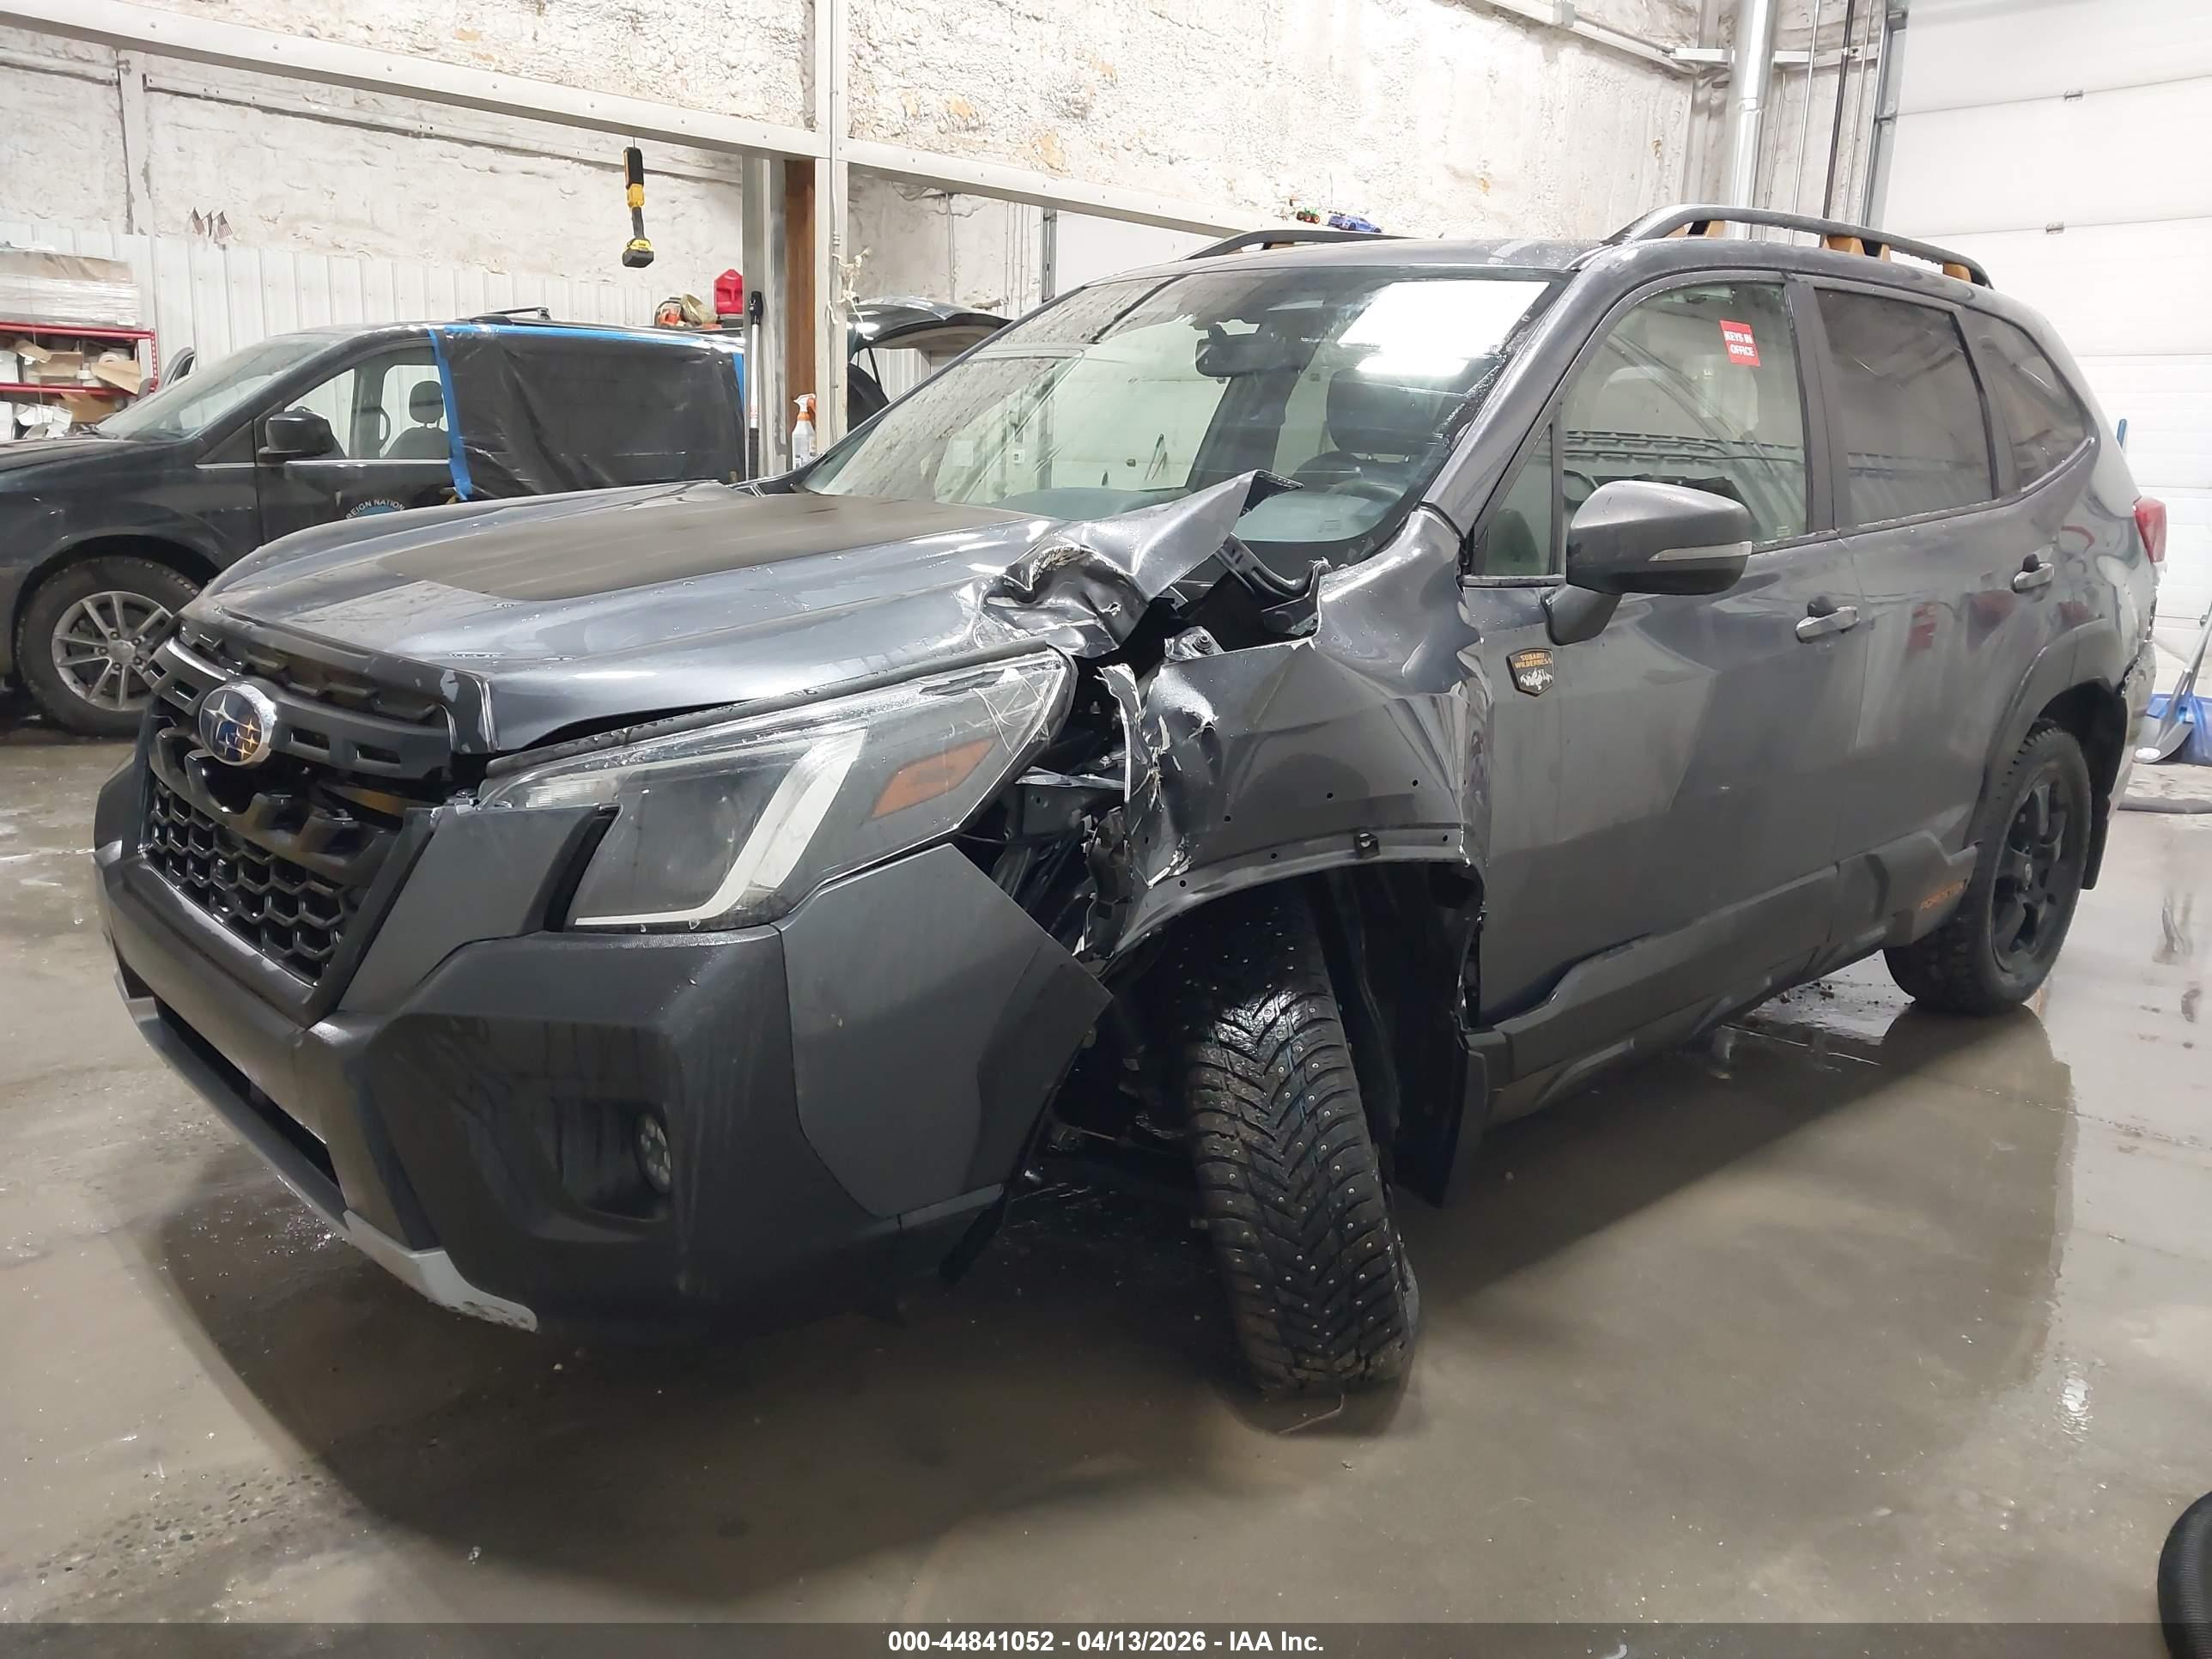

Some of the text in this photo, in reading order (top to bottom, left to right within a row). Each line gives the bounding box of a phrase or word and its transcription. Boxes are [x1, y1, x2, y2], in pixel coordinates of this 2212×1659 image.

[1724, 331, 1753, 343] KEYS IN
[1730, 344, 1754, 356] OFFICE
[374, 499, 405, 512] NATION
[1520, 652, 1545, 661] SUBARU
[1514, 658, 1553, 668] WILDERNESS
